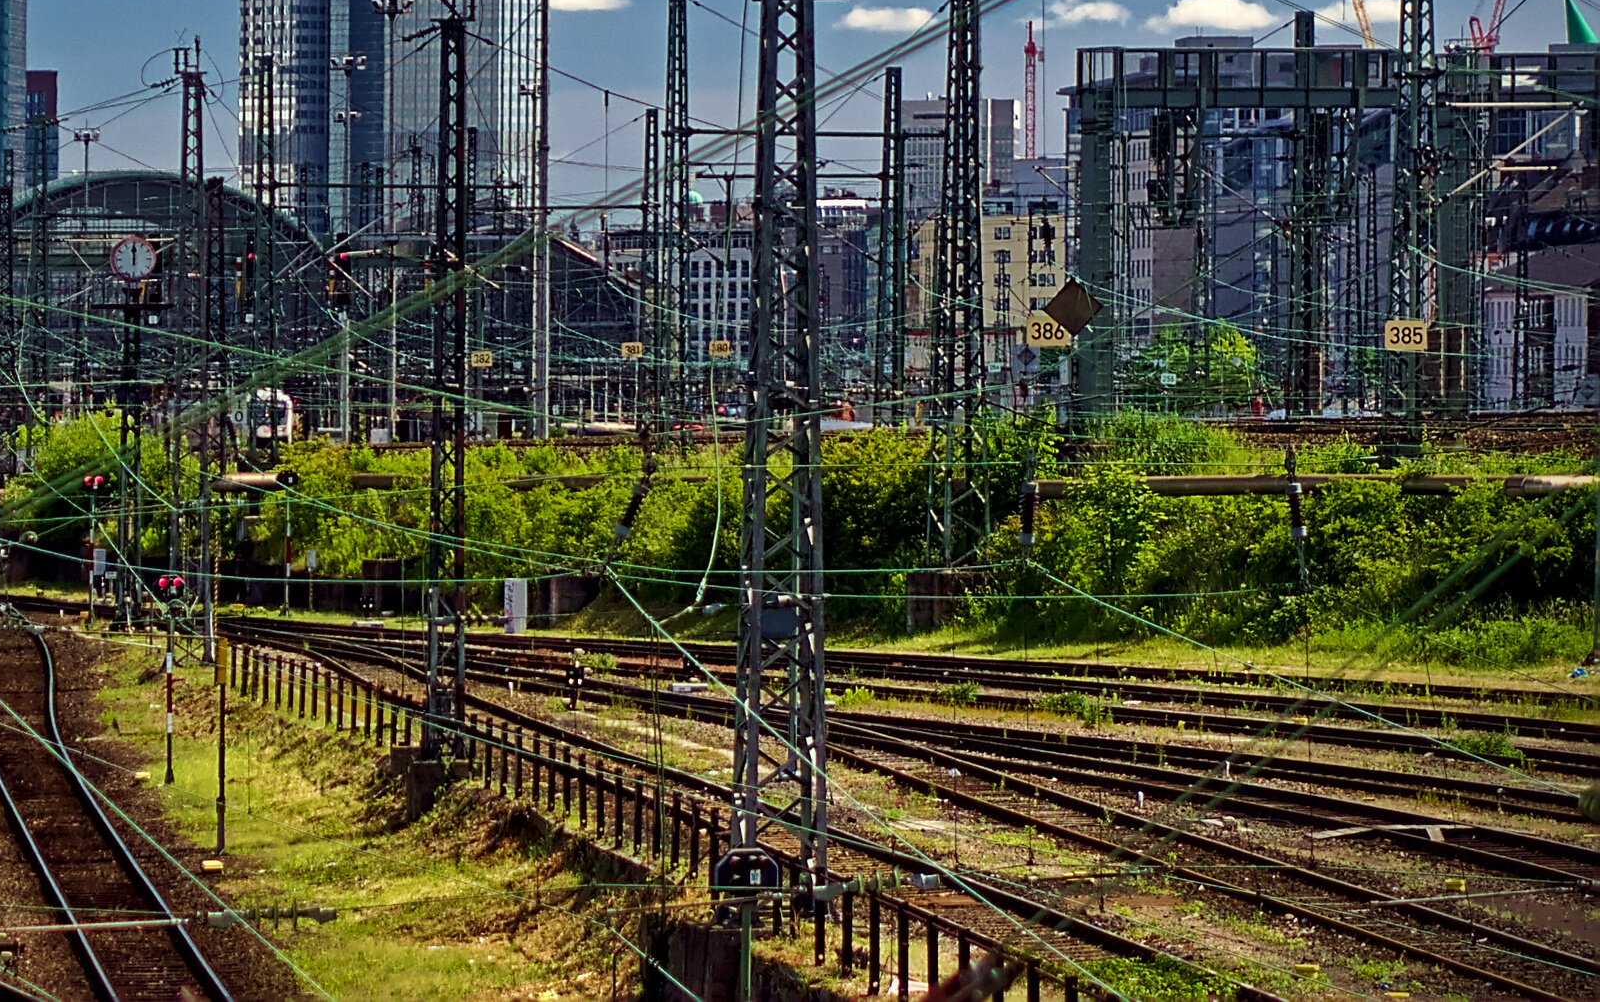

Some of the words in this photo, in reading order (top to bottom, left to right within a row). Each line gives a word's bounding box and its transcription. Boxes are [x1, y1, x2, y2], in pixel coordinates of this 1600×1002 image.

[1031, 322, 1064, 340] 386
[1390, 326, 1423, 344] 385
[474, 354, 490, 364] 382
